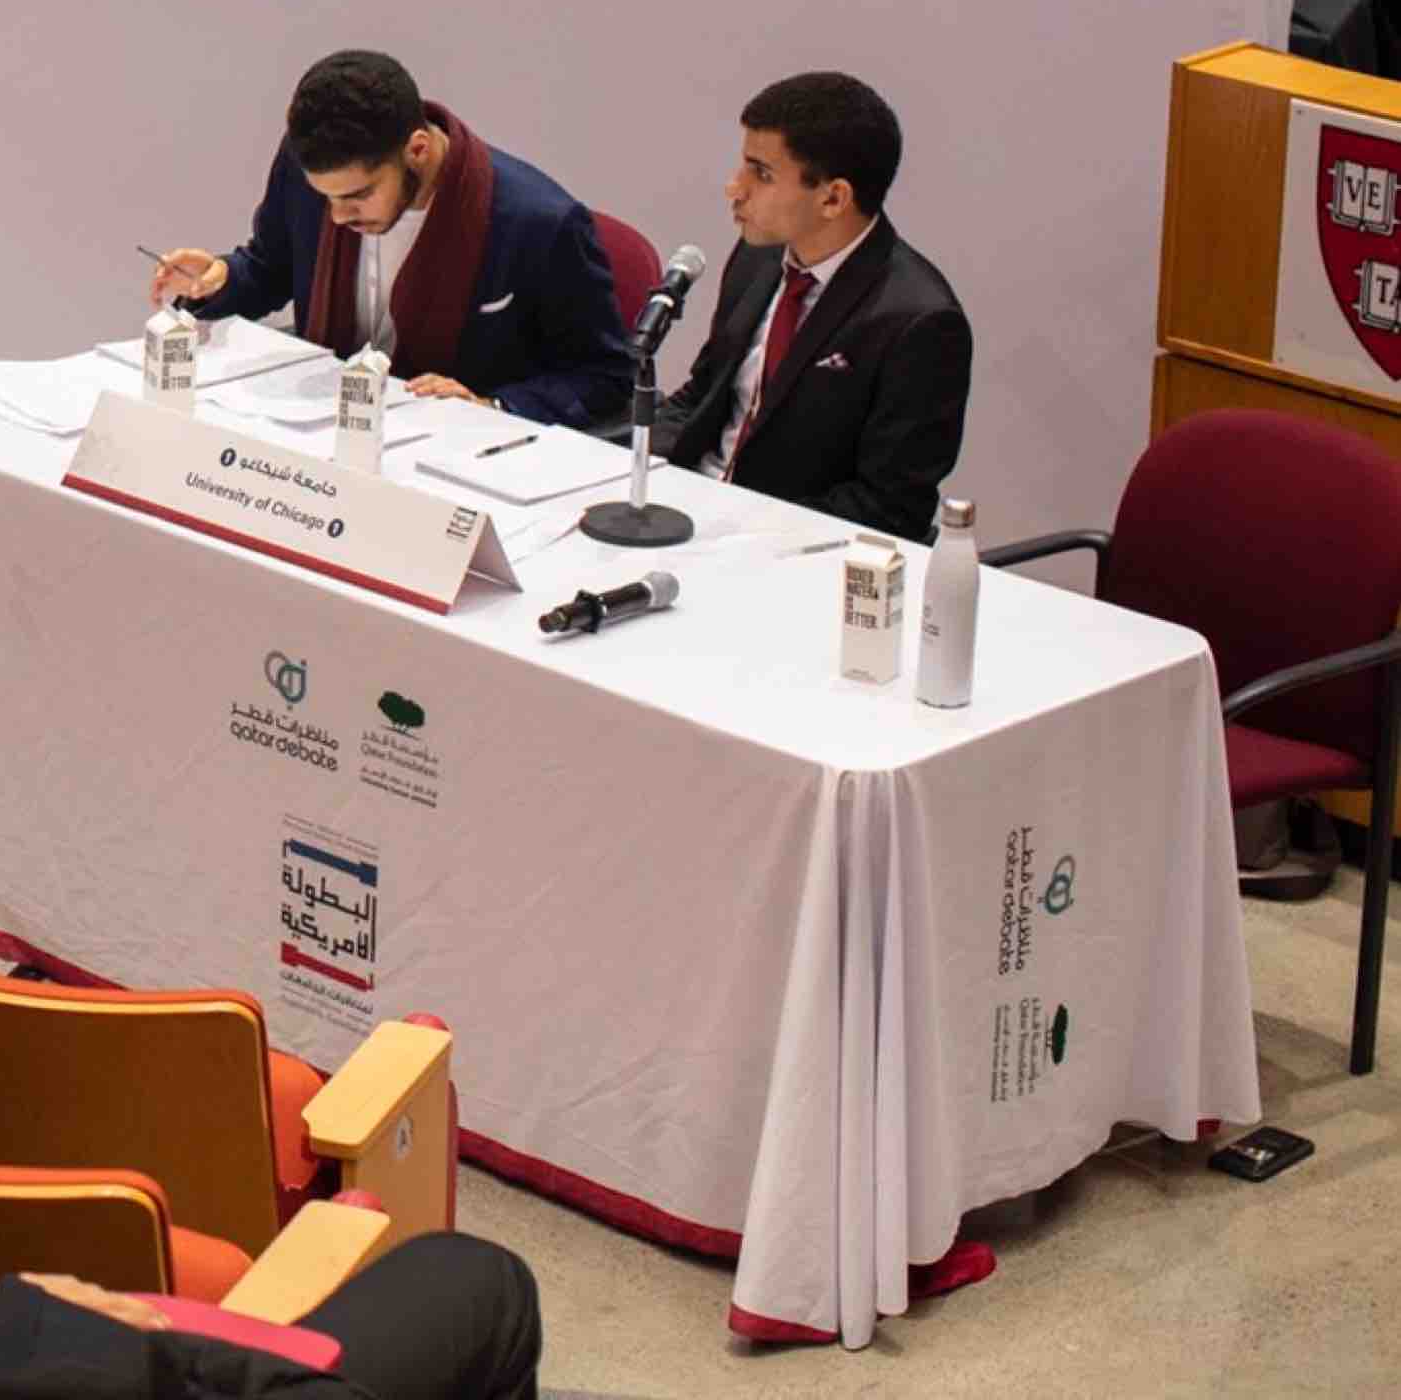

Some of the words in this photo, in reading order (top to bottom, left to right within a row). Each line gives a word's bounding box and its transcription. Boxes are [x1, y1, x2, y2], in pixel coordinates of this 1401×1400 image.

[1345, 174, 1382, 210] VE
[185, 471, 254, 507] University
[255, 494, 271, 511] of
[270, 499, 325, 531] Chicago
[293, 471, 339, 498] جامعة
